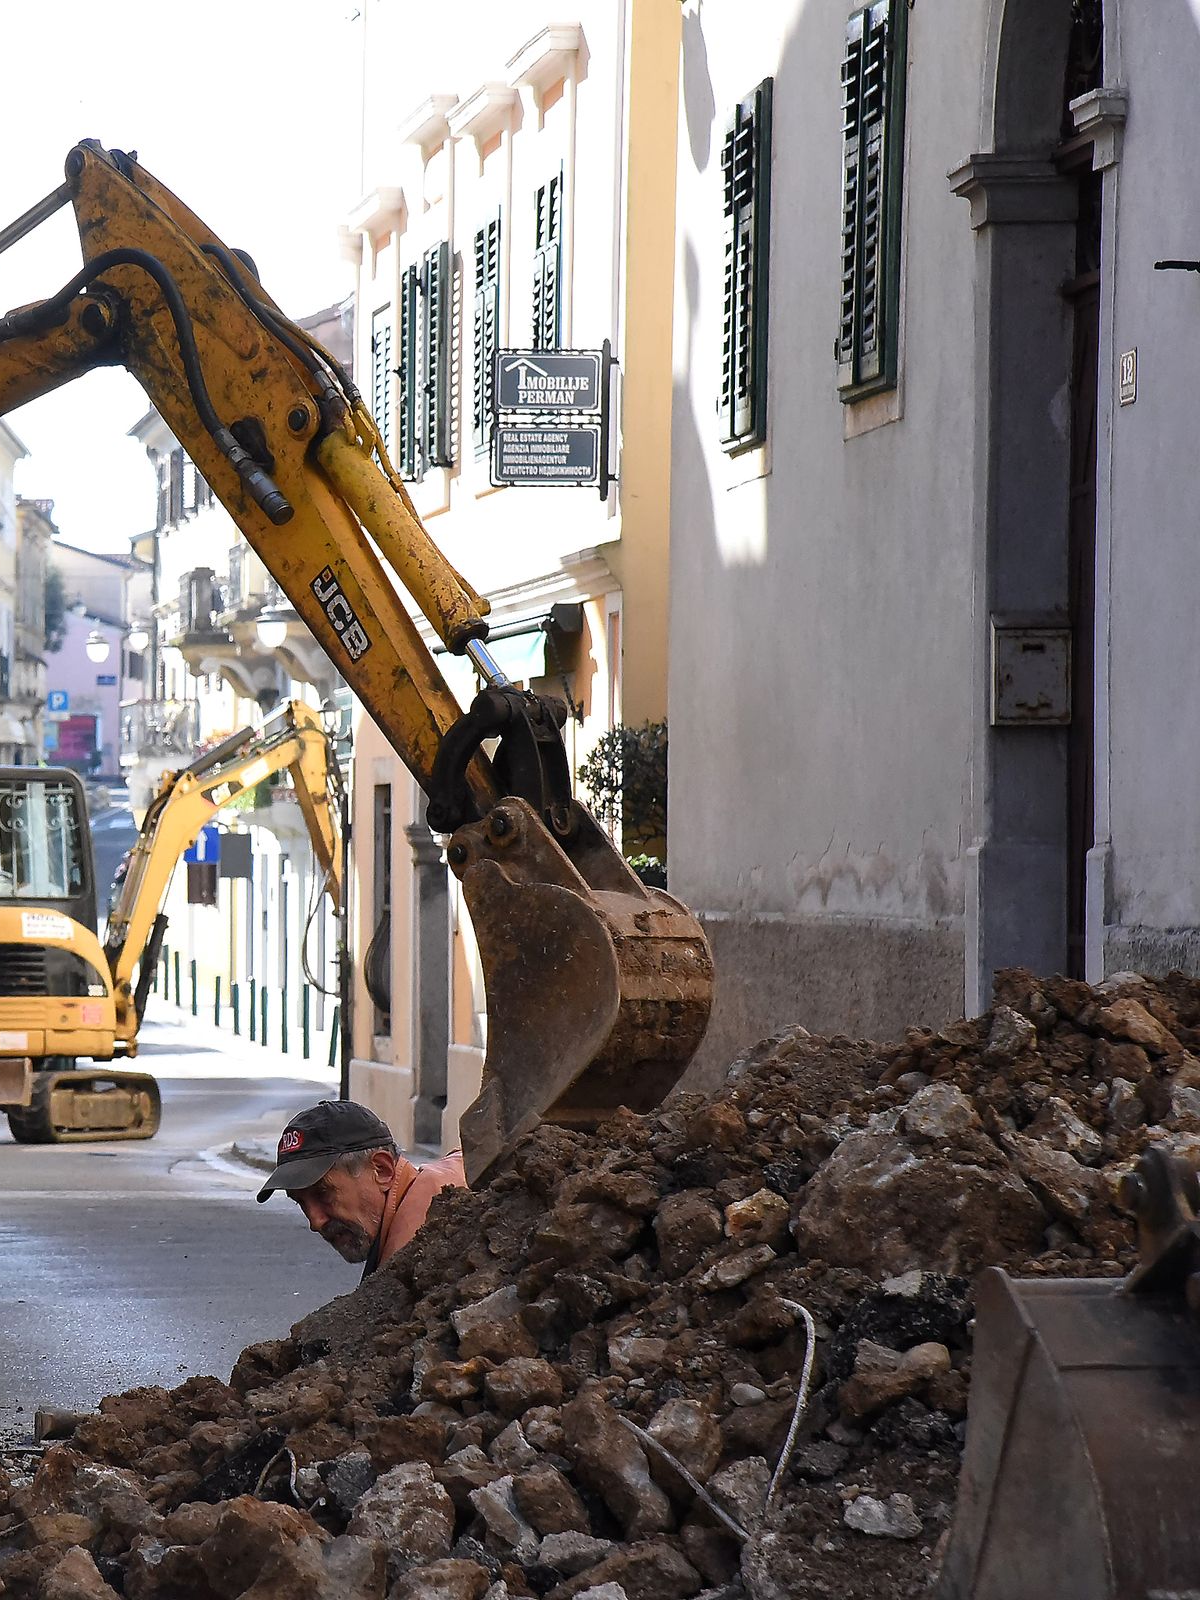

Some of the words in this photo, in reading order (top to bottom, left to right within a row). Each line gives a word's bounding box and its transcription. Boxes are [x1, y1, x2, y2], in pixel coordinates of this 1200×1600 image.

[517, 366, 589, 390] IMOBILIJE
[1122, 355, 1133, 385] 12
[518, 390, 575, 404] PERMAN
[503, 433, 519, 443] REAL
[520, 433, 542, 443] ESTATE
[543, 433, 568, 443] AGENCY
[503, 444, 529, 453] AGENZIA
[530, 444, 570, 453] IMMOBILIARE
[313, 577, 368, 660] JCB
[51, 693, 66, 710] P
